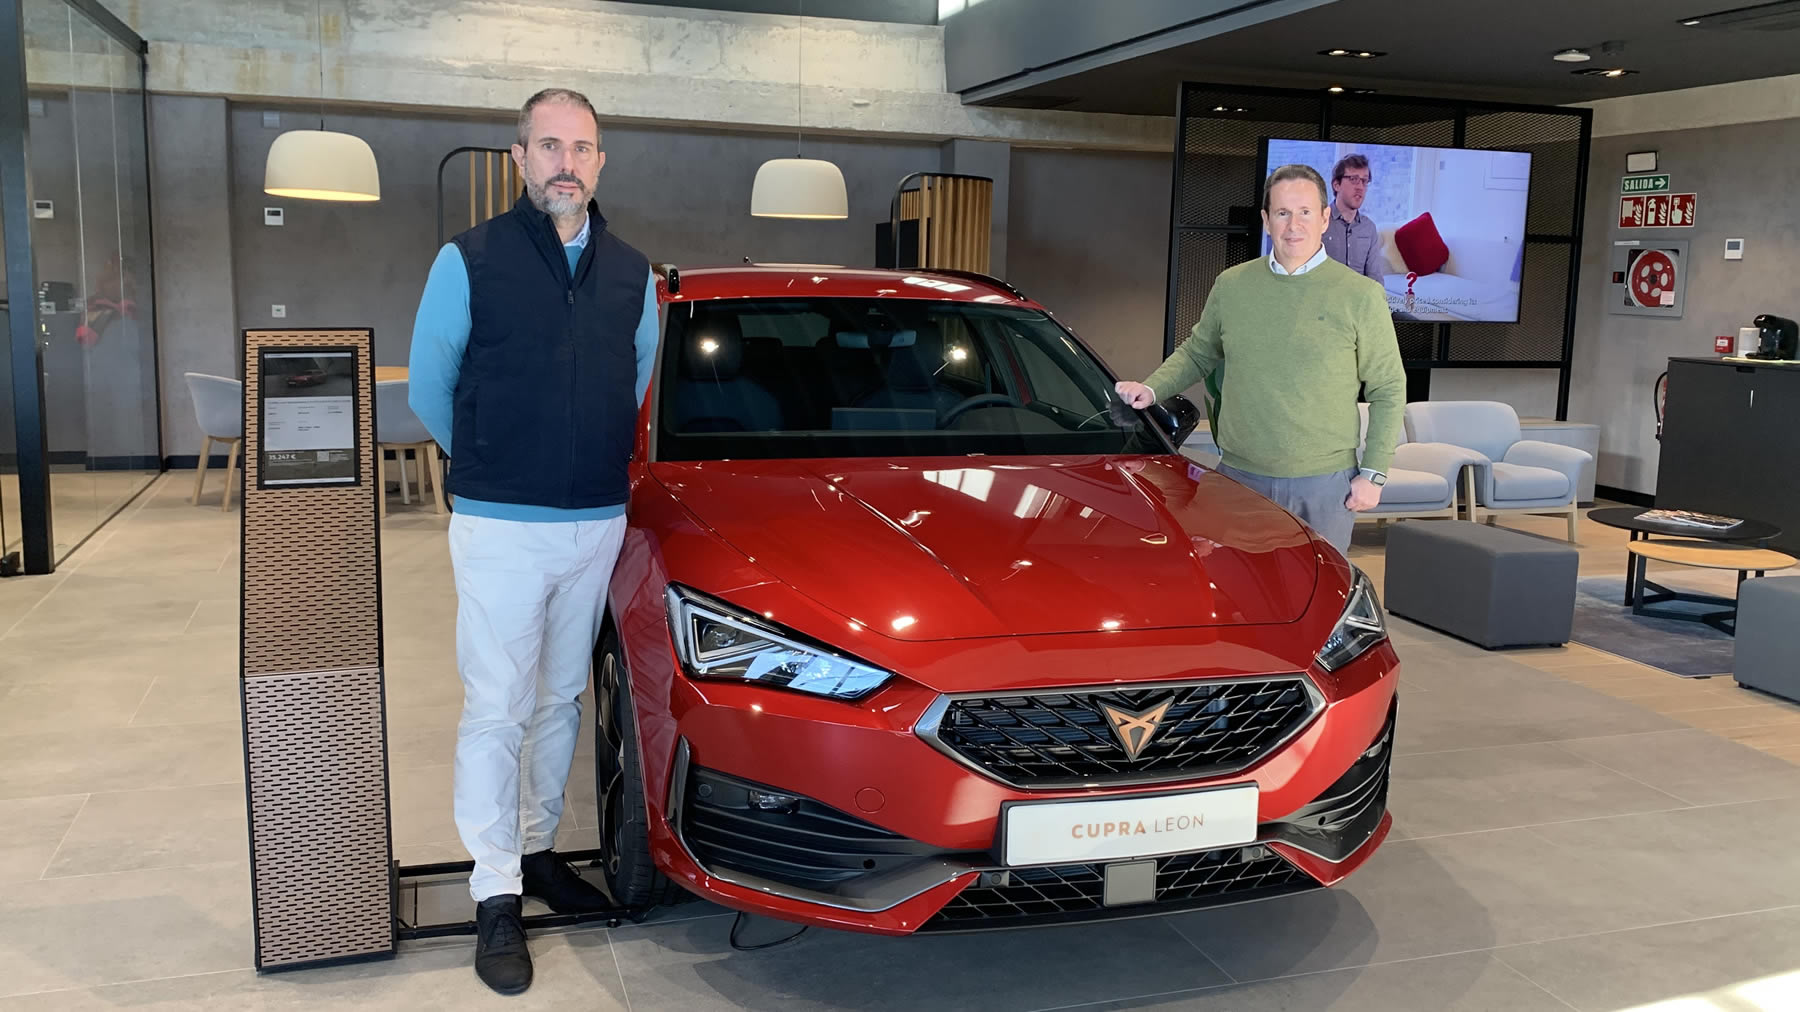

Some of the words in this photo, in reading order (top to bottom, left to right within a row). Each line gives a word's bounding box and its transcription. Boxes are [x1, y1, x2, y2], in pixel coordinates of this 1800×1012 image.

[1624, 178, 1654, 191] SALIDA
[1071, 820, 1146, 839] CUPRA
[1154, 813, 1204, 833] LEON
